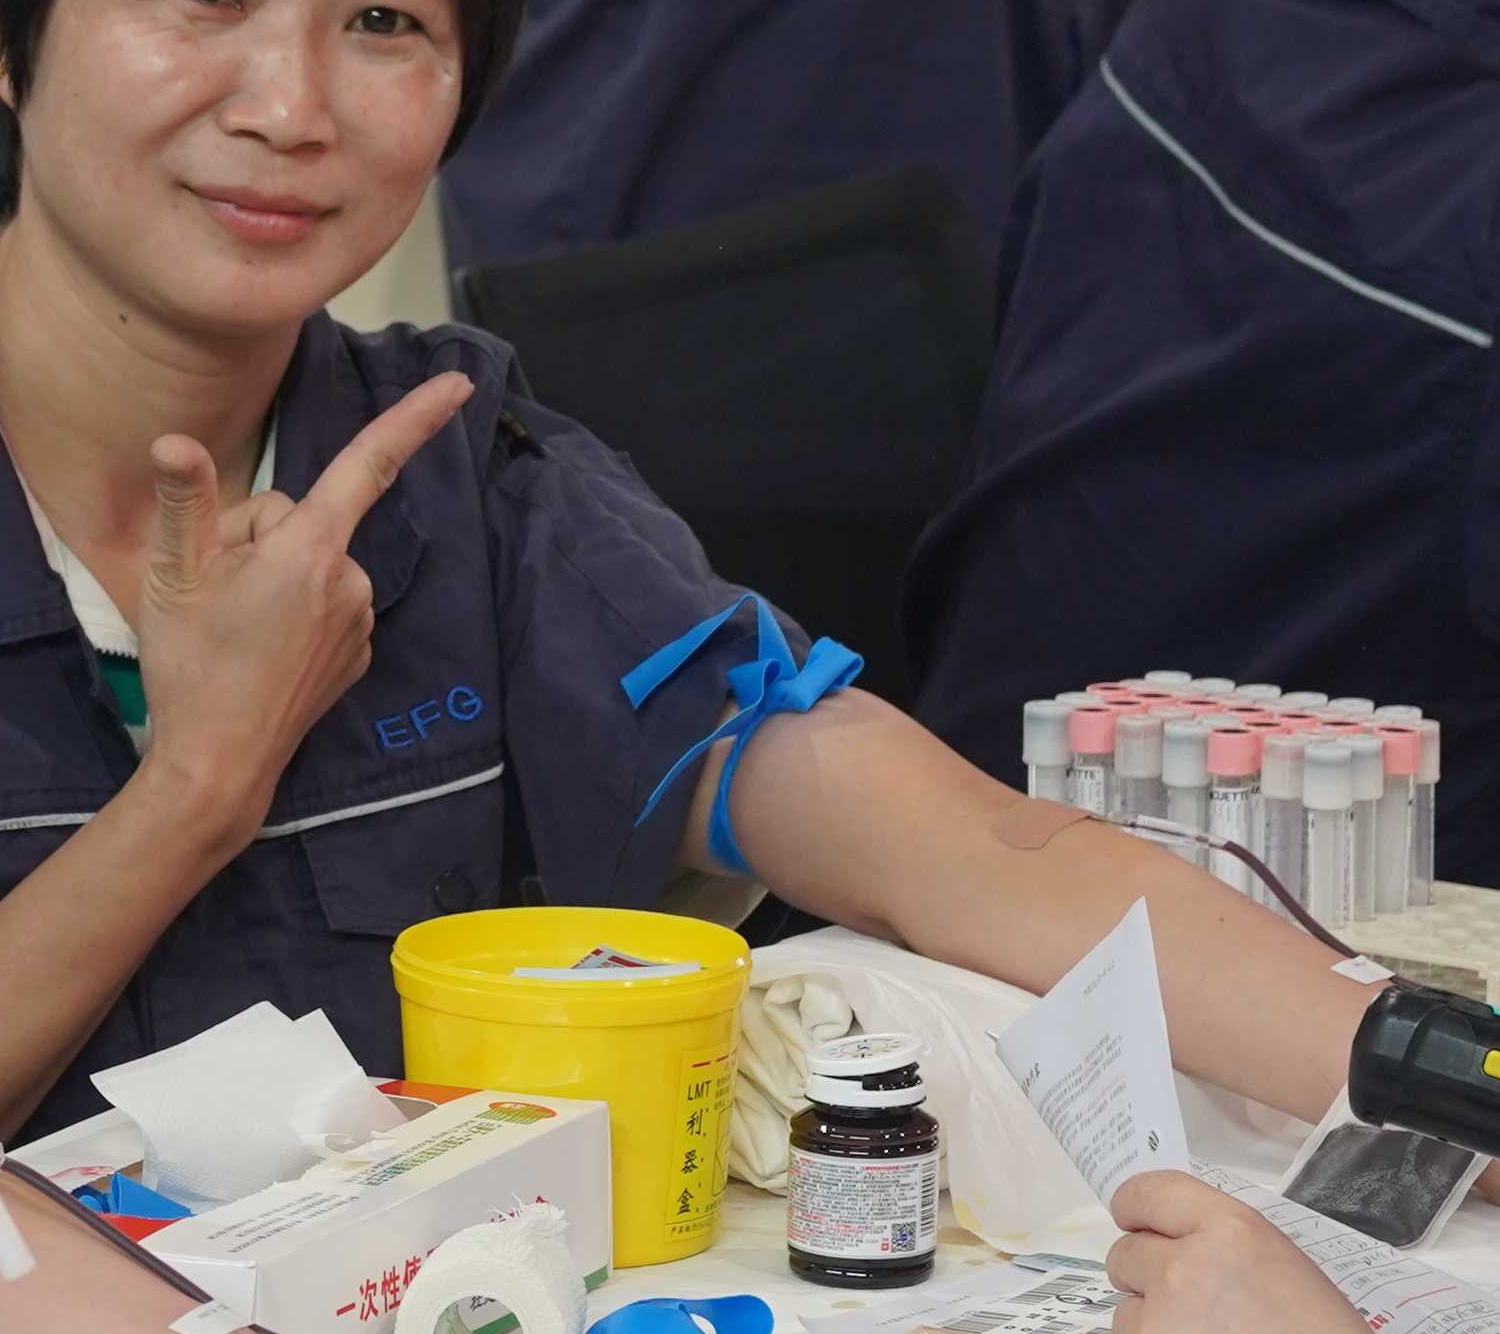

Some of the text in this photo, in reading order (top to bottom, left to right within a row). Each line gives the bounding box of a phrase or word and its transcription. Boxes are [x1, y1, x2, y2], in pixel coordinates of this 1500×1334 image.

[374, 685, 484, 750] EFG
[687, 1080, 711, 1101] LMT
[677, 1108, 704, 1216] 利器盒
[335, 1245, 440, 1322] 一次性使
